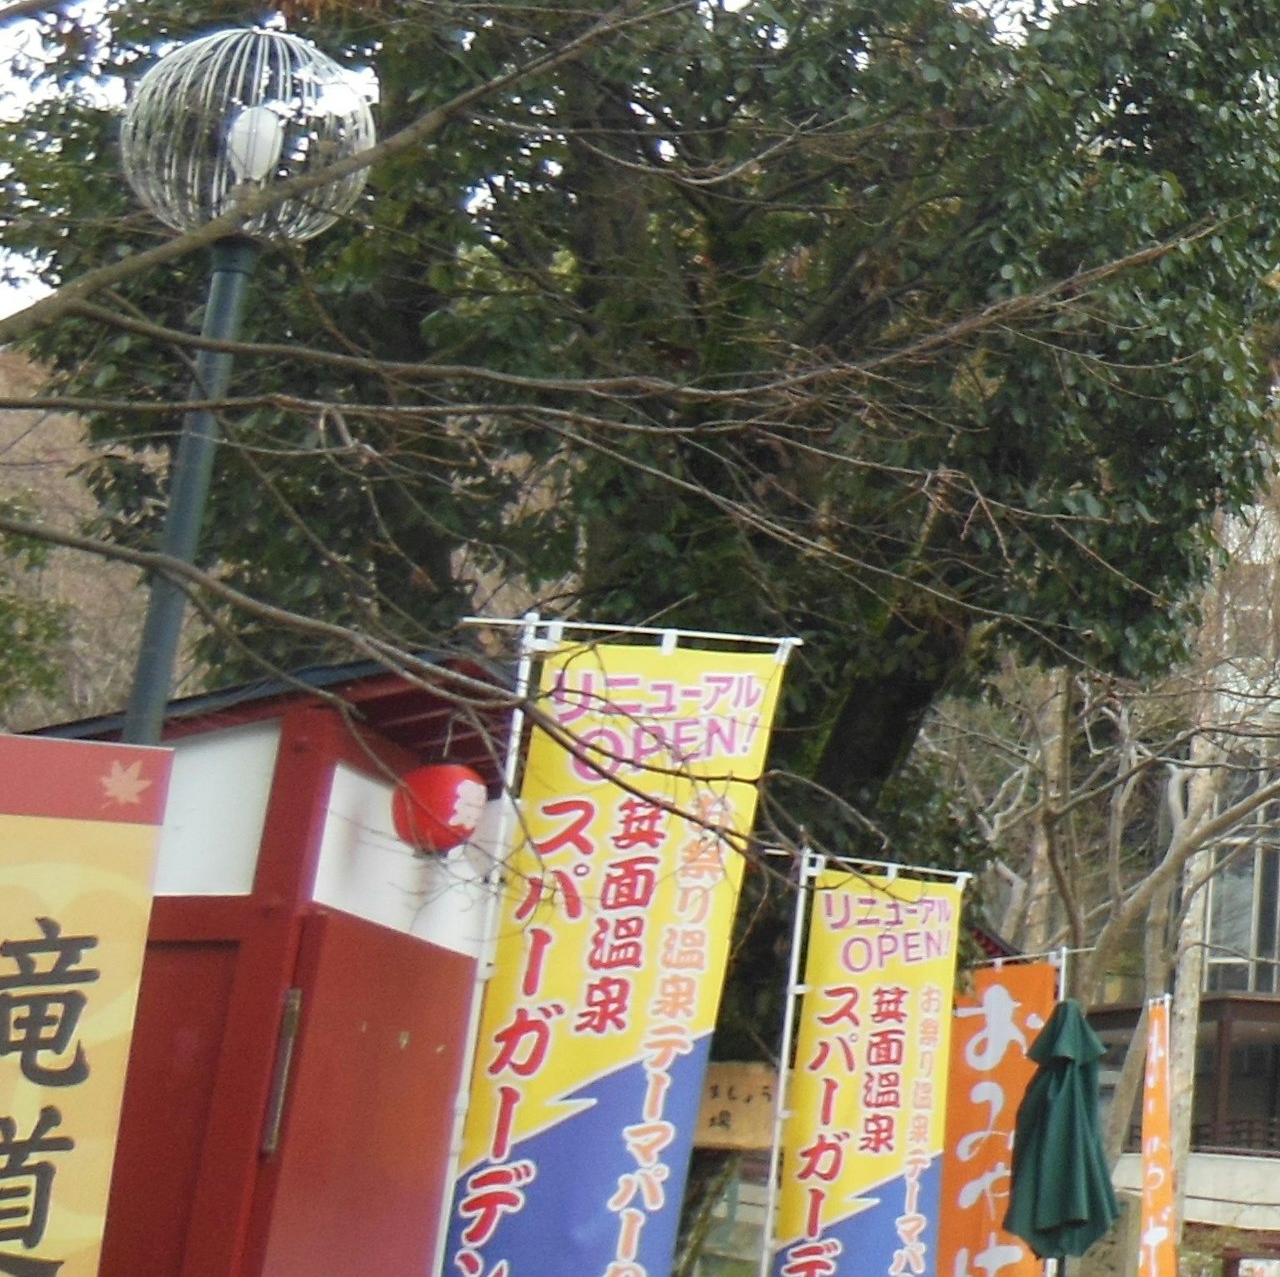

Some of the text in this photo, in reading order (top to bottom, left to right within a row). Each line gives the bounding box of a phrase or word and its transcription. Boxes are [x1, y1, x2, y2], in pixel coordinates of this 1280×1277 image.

[553, 672, 762, 721] リニューアル
[572, 717, 758, 782] OPEN!
[574, 797, 666, 1034] 箕面温泉
[823, 893, 952, 930] リニューアル
[858, 987, 908, 1153] 箕面温泉
